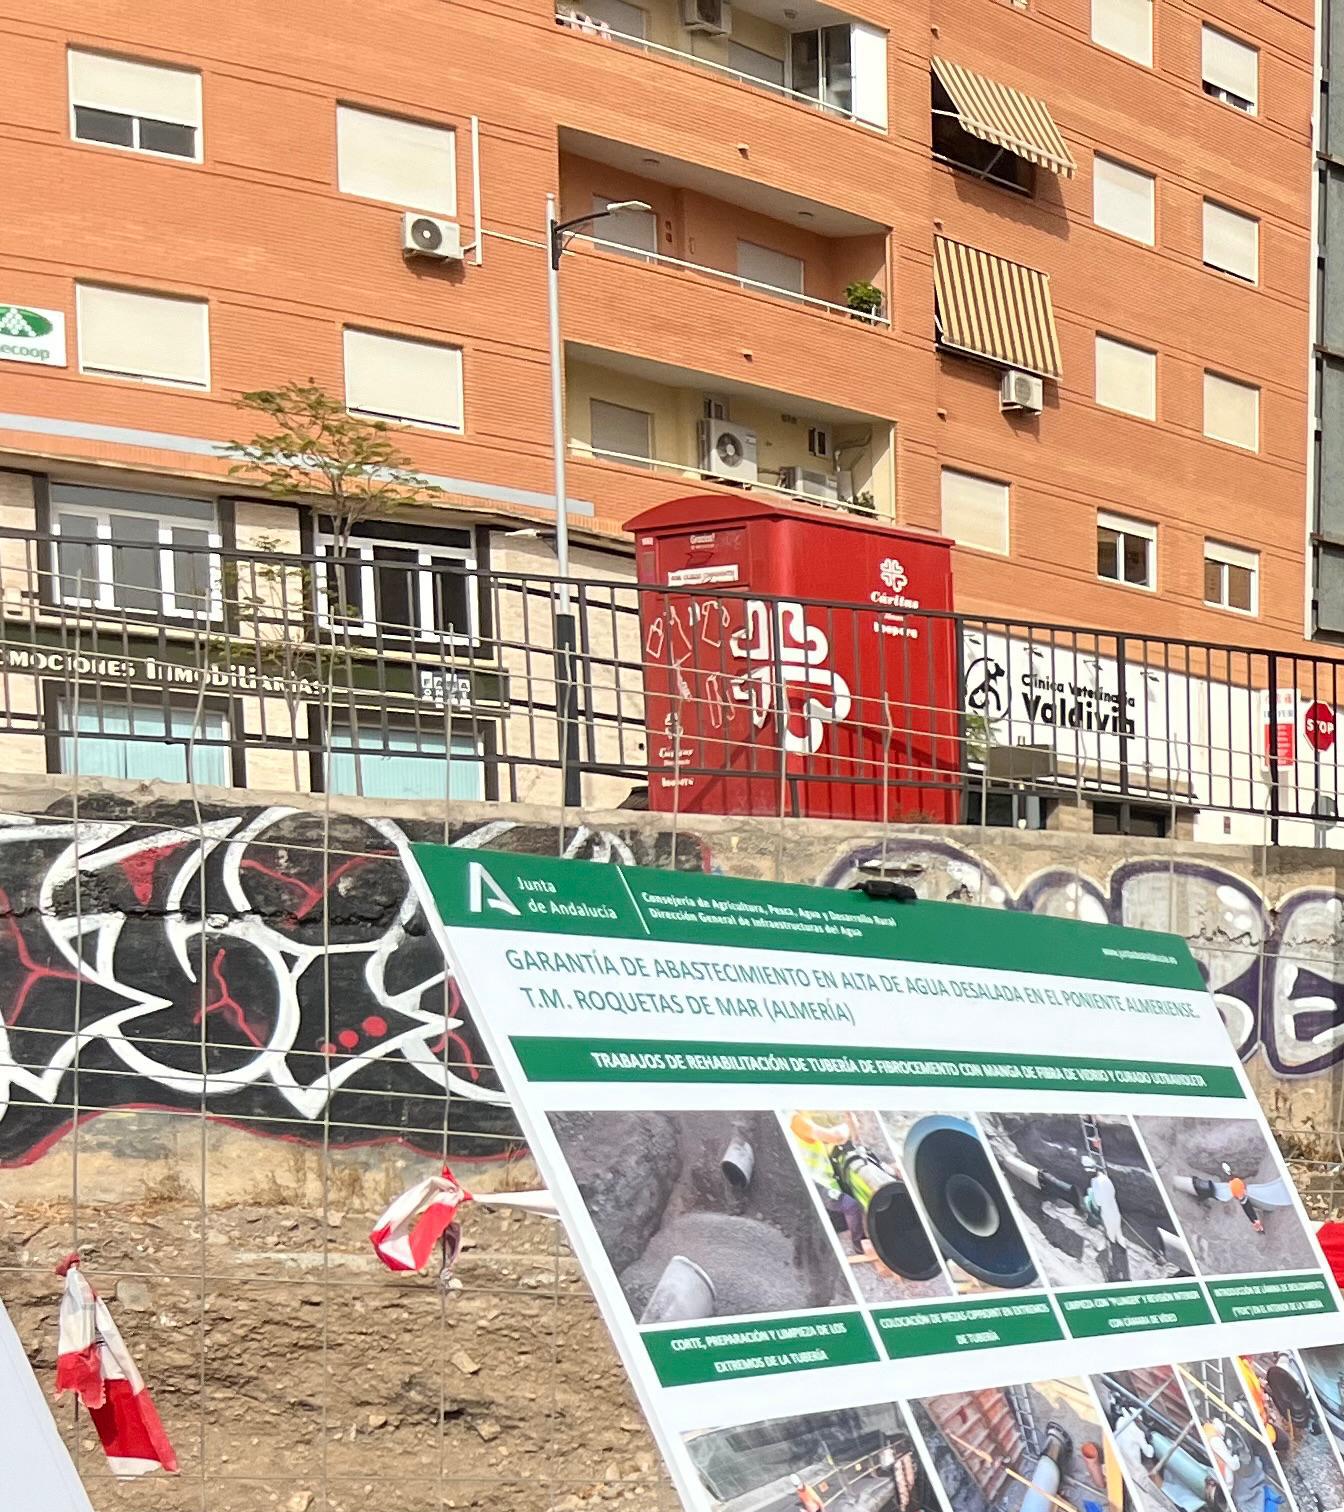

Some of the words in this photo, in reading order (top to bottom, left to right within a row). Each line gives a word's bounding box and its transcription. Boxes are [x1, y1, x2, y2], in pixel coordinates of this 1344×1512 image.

[1021, 673, 1065, 693] Cínica
[1021, 692, 1135, 739] Valdivia
[517, 877, 557, 893] Junta
[528, 898, 548, 913] de
[551, 901, 618, 919] Andalucía
[641, 892, 697, 908] Consejería
[698, 897, 711, 908] de
[767, 904, 799, 917] Pesca,
[799, 907, 822, 920] Agua
[822, 912, 829, 921] y
[828, 911, 874, 924] Desarrollo
[873, 915, 897, 927] Rural
[648, 908, 698, 922] Dirección
[698, 912, 737, 925] General
[738, 917, 751, 926] de
[751, 918, 825, 933] Infraestructuras
[824, 924, 841, 934] del
[841, 927, 863, 938] Agua
[505, 948, 620, 976] GARANTÍA
[619, 956, 651, 978] DE
[653, 959, 811, 987] ABASTECIMIENTO
[811, 969, 839, 989] EN
[840, 972, 880, 992] ALTA
[879, 974, 905, 994] DE
[905, 976, 948, 996] AGUA
[948, 979, 1025, 1004] DESALADA
[1023, 987, 1046, 1005] EN
[1044, 989, 1064, 1006] EL
[1061, 990, 1126, 1012] PONIENTE
[520, 986, 572, 1010] T.M.
[573, 990, 684, 1015] ROQUETAS
[685, 995, 716, 1016] DE
[715, 997, 763, 1018] MAR
[762, 998, 856, 1026] (ALMERÍA)
[590, 1052, 666, 1069] TRABAJOS
[664, 1054, 688, 1069] DE
[685, 1053, 791, 1072] REHABILITACIÓN
[788, 1058, 810, 1072] DE
[808, 1056, 861, 1073] TUBERÍA
[859, 1060, 878, 1073] DE
[875, 1060, 960, 1076] FIBROCEMENTO
[959, 1063, 982, 1076] CON
[981, 1064, 1021, 1078] MANGA
[1020, 1065, 1039, 1079] DE
[1037, 1066, 1065, 1079] FIBRA
[1061, 1068, 1079, 1080] DE
[1078, 1068, 1109, 1082] VIDRIO
[1107, 1070, 1117, 1082] Y
[1115, 1071, 1152, 1084] CURADO
[1151, 1072, 1208, 1087] ULTRAVIOLETA
[705, 1329, 772, 1347] PREPARACIÓN
[769, 1329, 777, 1340] Y
[775, 1326, 817, 1340] LIMPIEZA
[816, 1323, 831, 1336] DE
[830, 1322, 848, 1334] LOS
